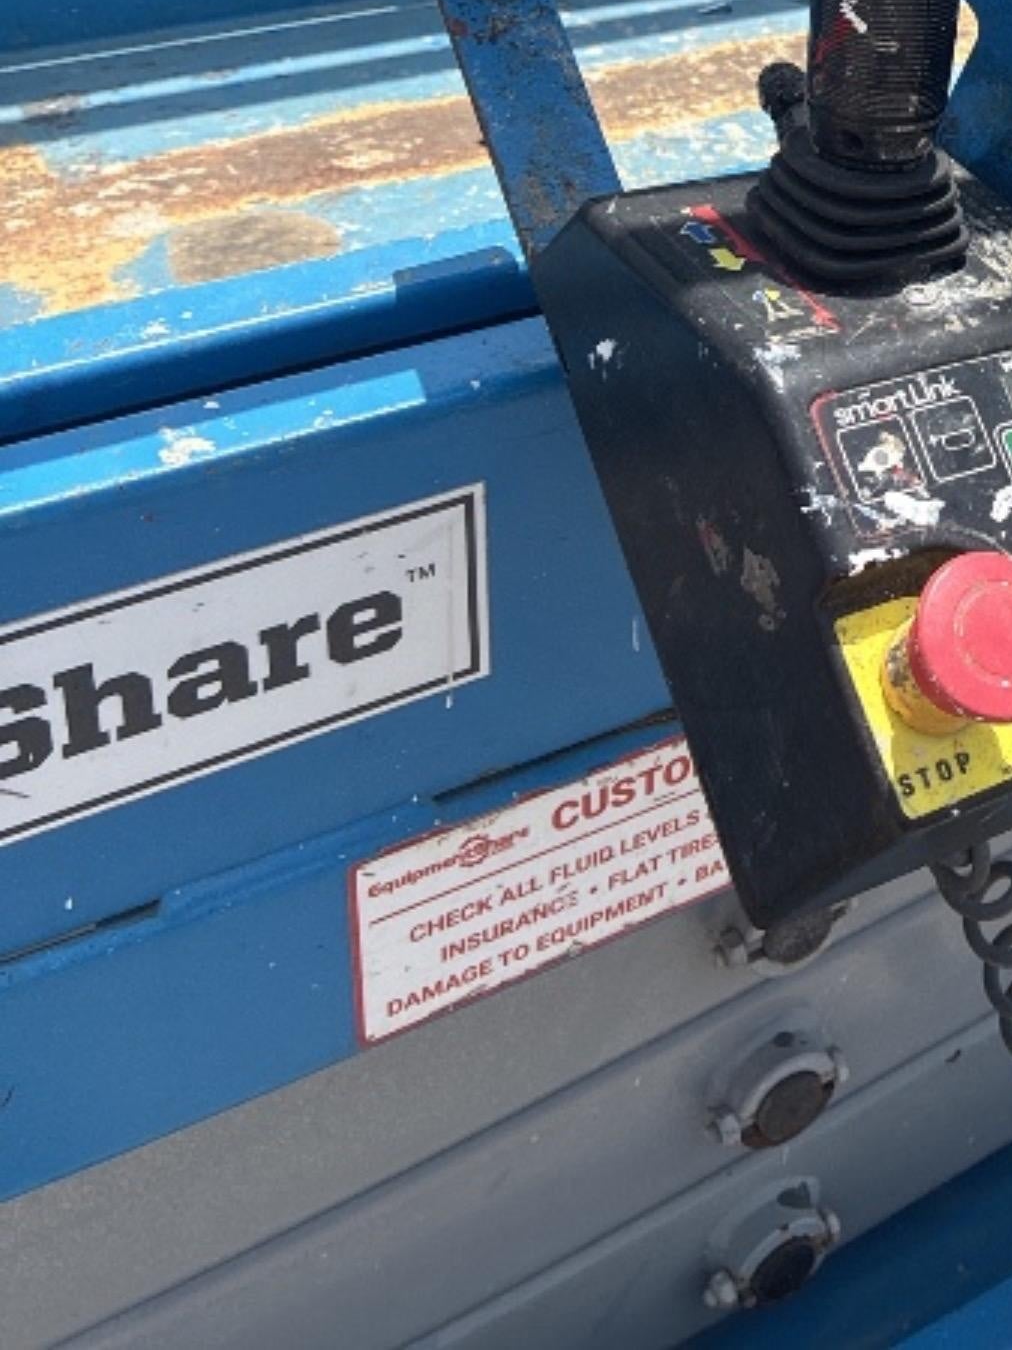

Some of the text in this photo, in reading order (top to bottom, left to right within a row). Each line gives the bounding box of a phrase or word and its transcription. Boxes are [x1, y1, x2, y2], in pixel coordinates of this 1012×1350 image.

[897, 752, 971, 797] STOP
[409, 809, 701, 944] CHECK ALL FLUID LEVELS
[440, 890, 579, 963] INSURANCE
[608, 853, 660, 892] FLAT
[386, 961, 495, 1018] DAMAGE
[499, 944, 530, 968] TO
[536, 881, 669, 953] EQUIPMENT
